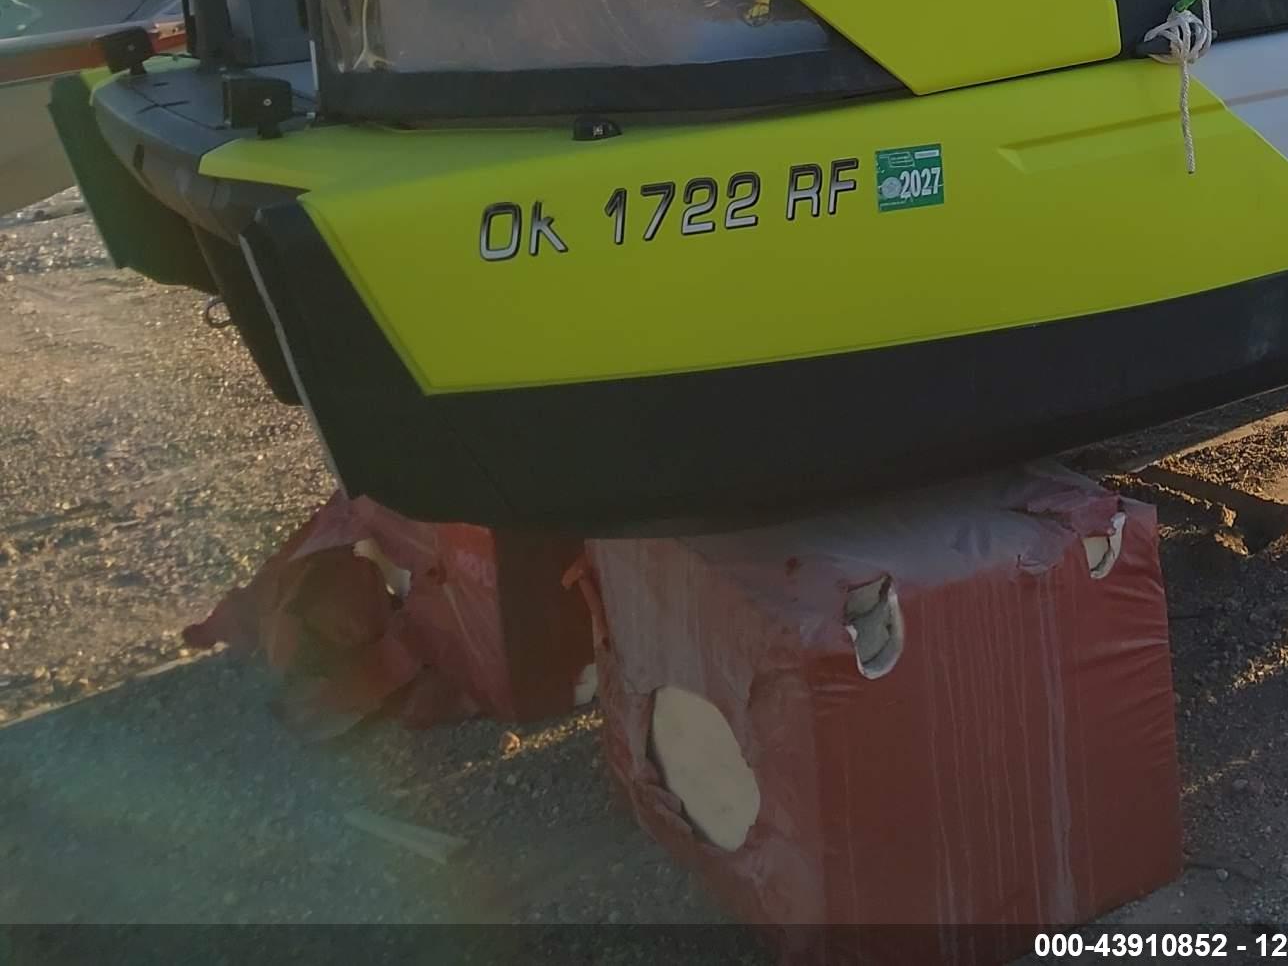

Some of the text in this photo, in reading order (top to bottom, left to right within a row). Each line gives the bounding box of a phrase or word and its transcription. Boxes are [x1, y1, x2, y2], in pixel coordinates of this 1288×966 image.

[604, 171, 761, 245] 1722
[785, 157, 859, 221] RF
[900, 167, 941, 199] 2027
